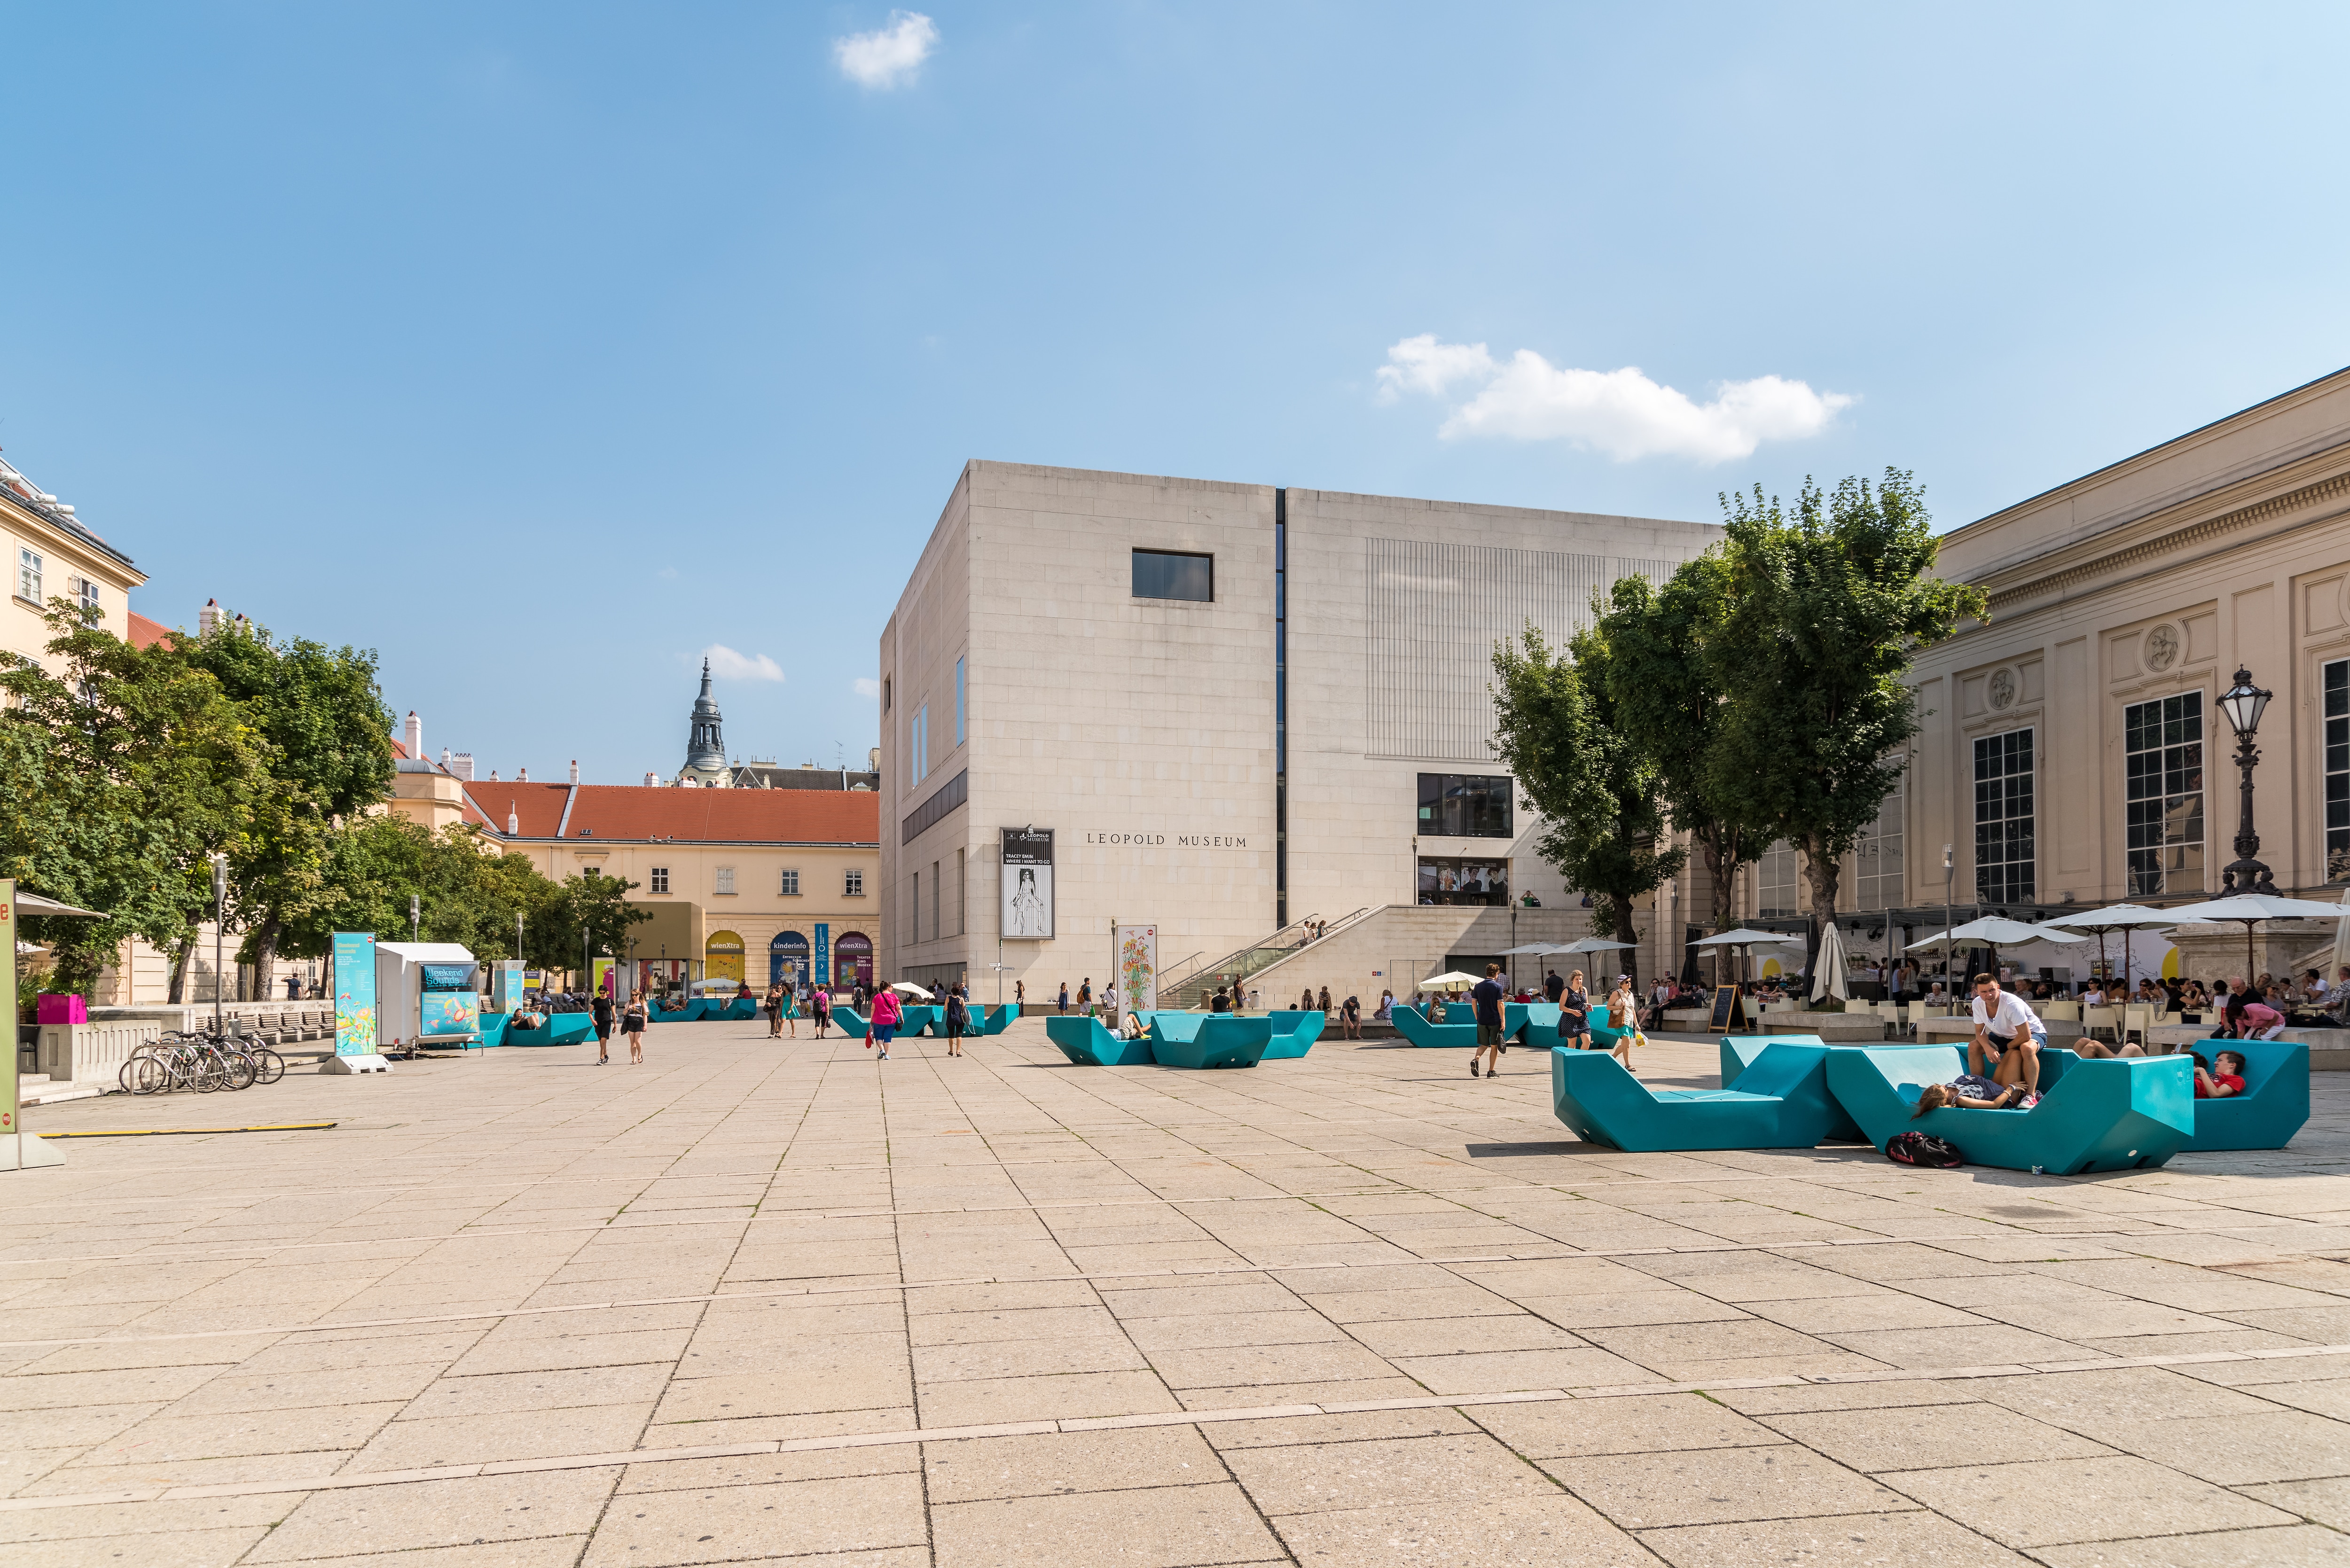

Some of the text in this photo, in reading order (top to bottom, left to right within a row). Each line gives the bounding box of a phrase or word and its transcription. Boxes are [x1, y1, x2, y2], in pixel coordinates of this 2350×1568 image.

[1088, 833, 1246, 847] LEOPOLD MUSEUM
[426, 976, 460, 985] Sounds
